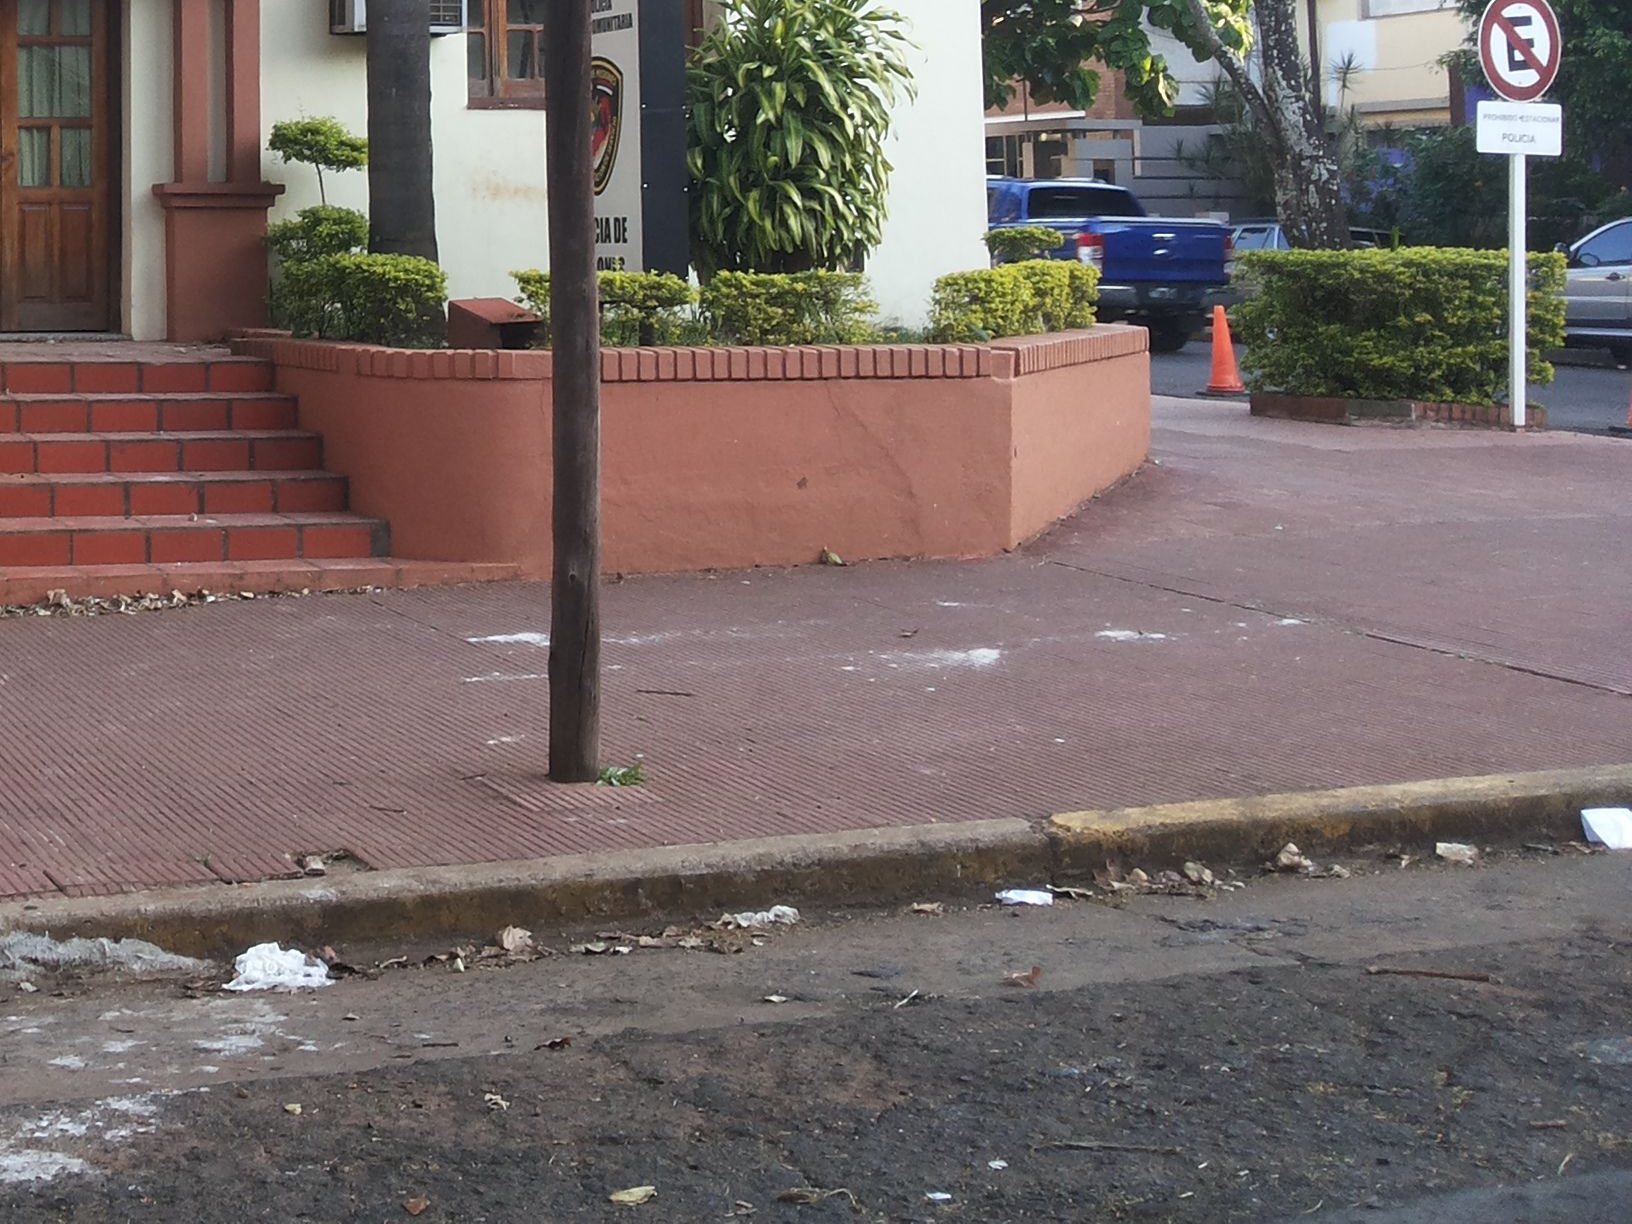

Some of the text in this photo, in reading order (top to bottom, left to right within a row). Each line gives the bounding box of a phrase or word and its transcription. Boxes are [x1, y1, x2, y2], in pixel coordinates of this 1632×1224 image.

[591, 13, 633, 35] OMUNITARIA
[1504, 15, 1536, 72] E
[1501, 132, 1536, 143] POLICIA
[613, 217, 628, 244] DE
